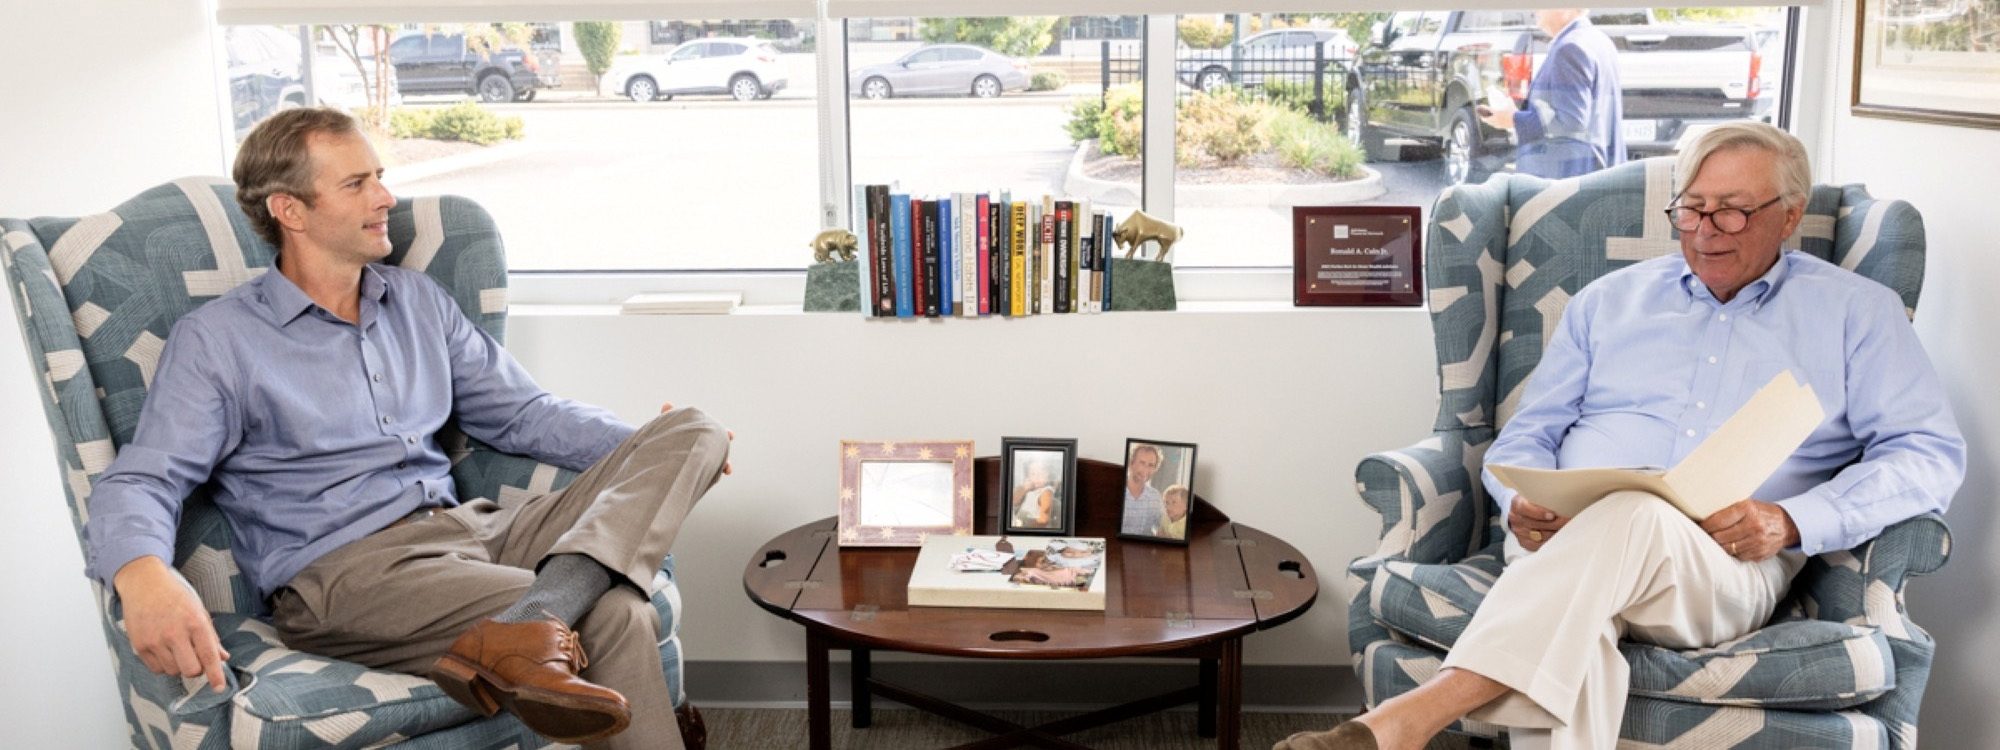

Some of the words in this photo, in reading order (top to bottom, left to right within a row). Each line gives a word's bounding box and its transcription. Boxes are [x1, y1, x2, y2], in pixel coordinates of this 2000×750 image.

[1016, 206, 1025, 226] DEEP
[964, 212, 973, 252] Atomic
[1016, 230, 1025, 256] WORK
[965, 256, 975, 292] Habits
